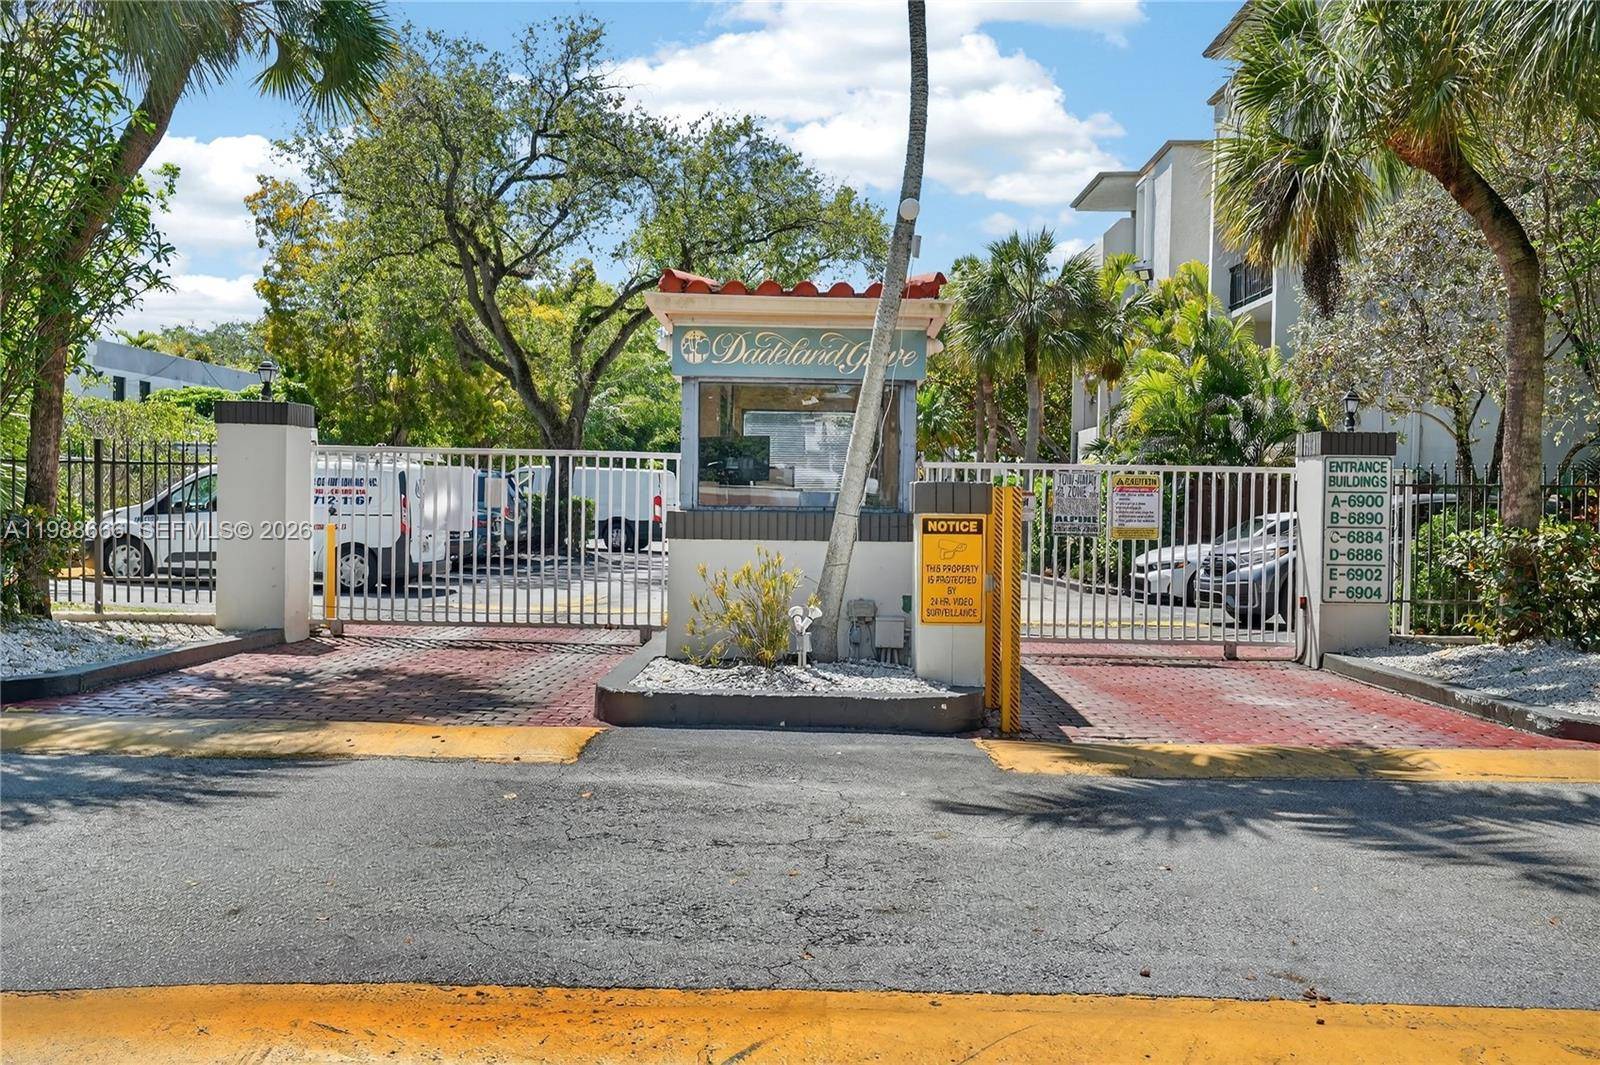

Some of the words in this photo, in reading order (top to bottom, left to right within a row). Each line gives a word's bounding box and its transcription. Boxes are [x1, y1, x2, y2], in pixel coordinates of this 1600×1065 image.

[712, 329, 849, 368] Dadeland
[839, 340, 918, 375] Gve
[1329, 461, 1387, 473] ENTRANCE
[1124, 478, 1157, 486] CAUTION
[1328, 476, 1387, 488] BUILDINGS
[1331, 495, 1384, 508] A-6900
[1055, 515, 1098, 523] ALPINE
[1330, 512, 1384, 525] B-6890
[927, 520, 978, 532] NOTICE
[1330, 531, 1384, 544] C-6884
[1329, 549, 1383, 562] D-6886
[926, 564, 941, 573] THIS
[942, 564, 979, 573] PROPERTY
[927, 575, 935, 584] IS
[935, 575, 977, 584] PROTECTED
[1329, 568, 1383, 582] E-6902
[947, 586, 956, 595] BY
[1328, 586, 1382, 600] F-6904
[930, 597, 939, 606] 24
[953, 597, 974, 606] VIDEO
[926, 608, 978, 617] SURVEILLANCE
